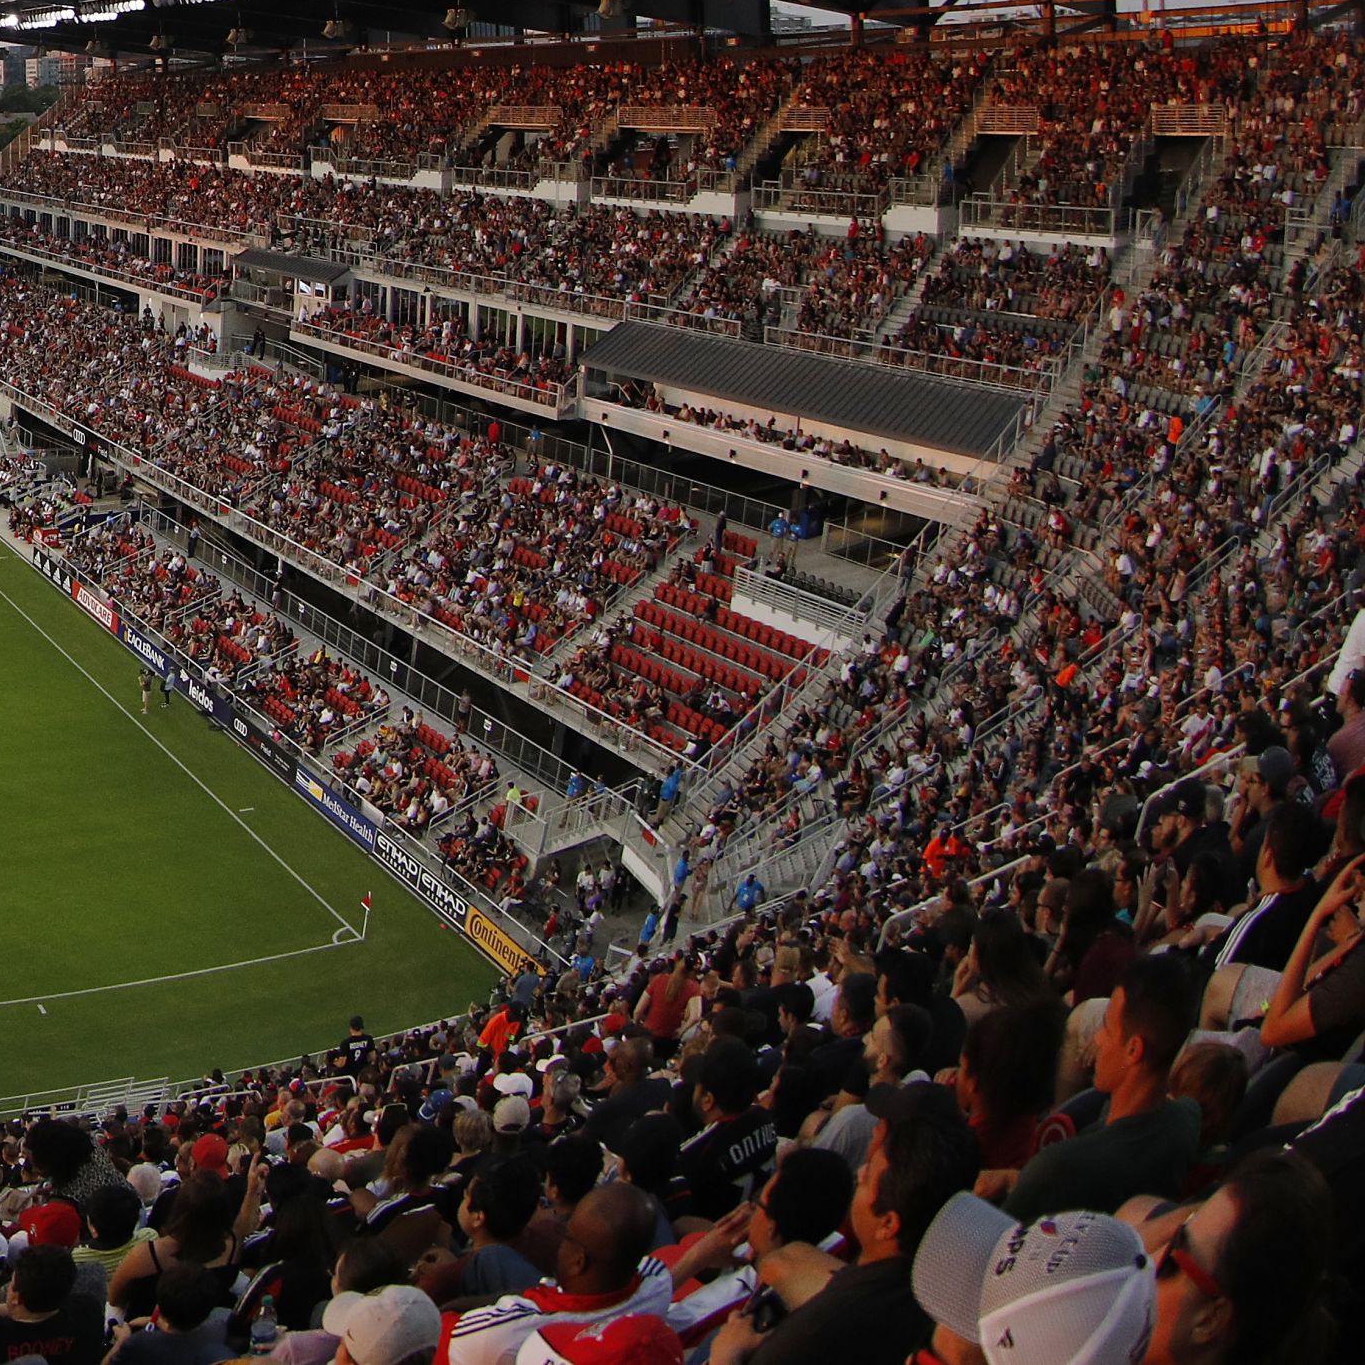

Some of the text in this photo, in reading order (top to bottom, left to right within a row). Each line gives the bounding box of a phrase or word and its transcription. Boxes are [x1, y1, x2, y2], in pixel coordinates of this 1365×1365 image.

[77, 589, 112, 626] ADVOCARE
[188, 679, 214, 712] leidos
[321, 794, 373, 844] MedStar Health
[377, 834, 418, 876] ETIHAD
[421, 873, 466, 916] ETIHAD
[355, 1050, 361, 1061] 9
